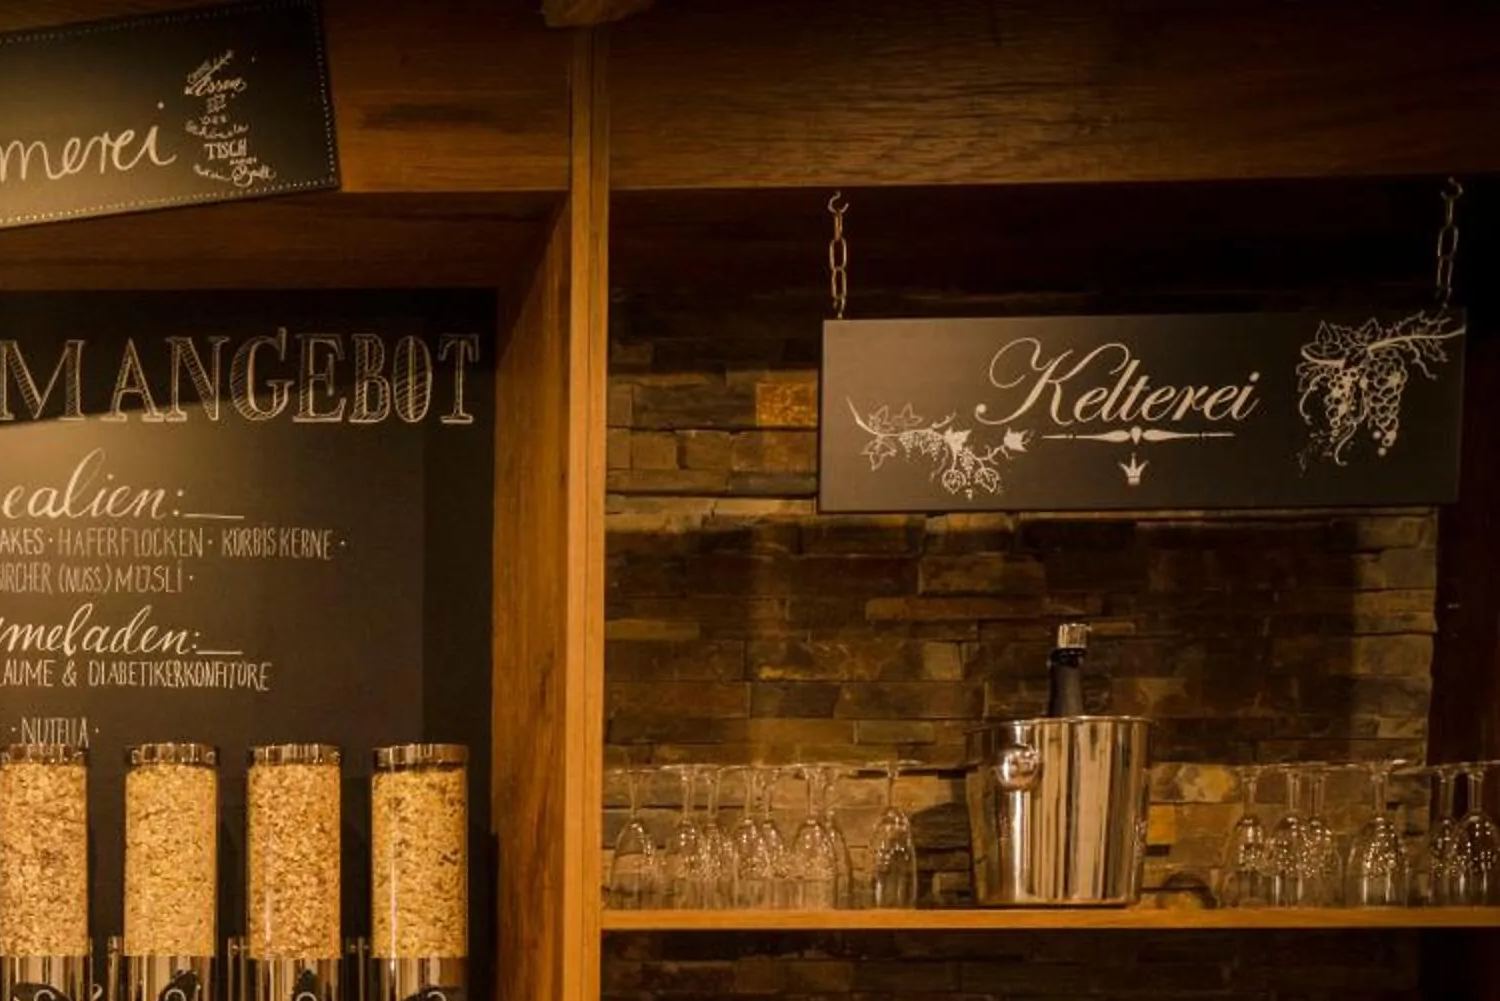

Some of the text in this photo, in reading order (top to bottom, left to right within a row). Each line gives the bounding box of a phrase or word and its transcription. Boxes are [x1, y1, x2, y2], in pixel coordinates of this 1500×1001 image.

[100, 327, 481, 425] ANGEBOT
[974, 336, 1263, 427] Kelterei
[57, 526, 204, 558] HAFERFLOCKEN
[61, 659, 79, 688] &
